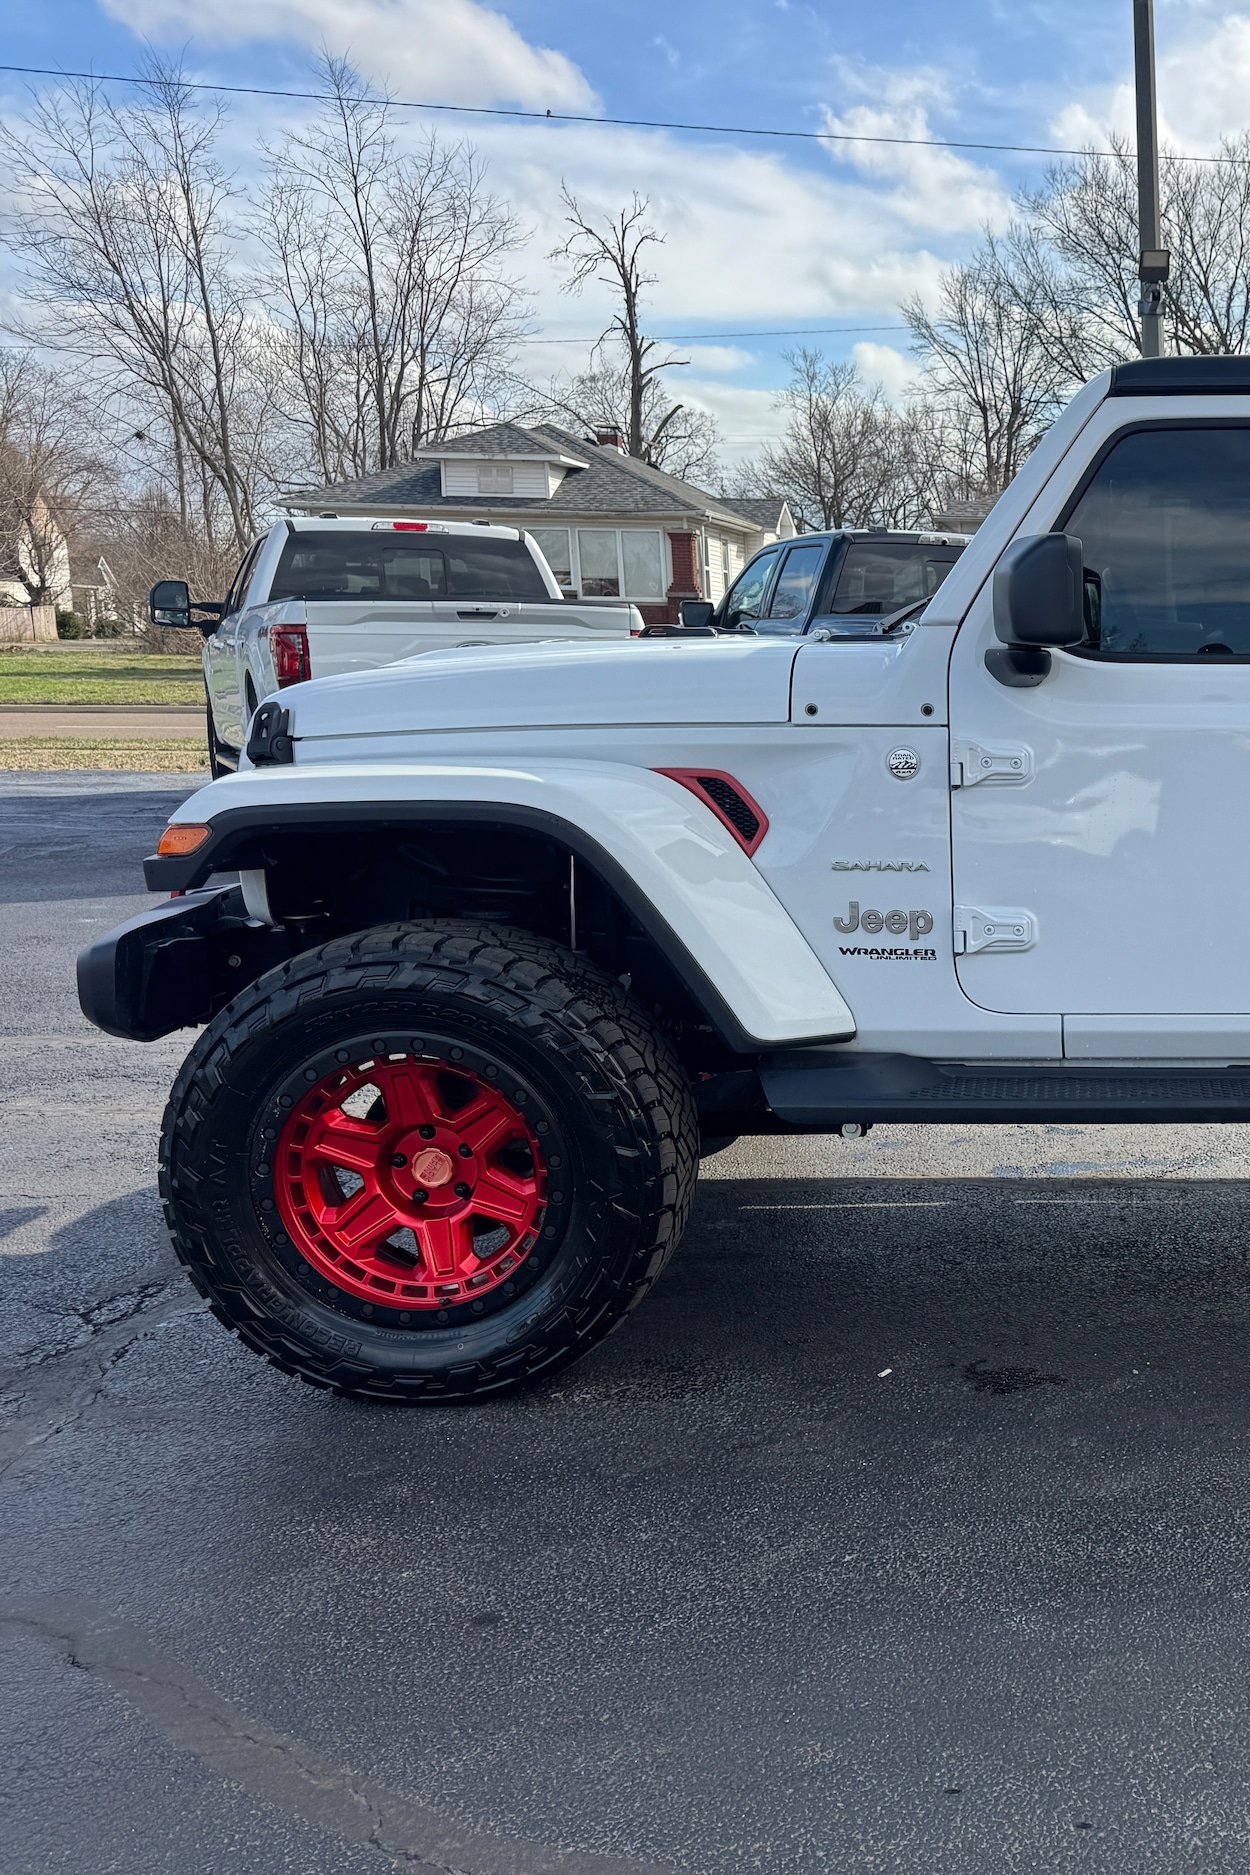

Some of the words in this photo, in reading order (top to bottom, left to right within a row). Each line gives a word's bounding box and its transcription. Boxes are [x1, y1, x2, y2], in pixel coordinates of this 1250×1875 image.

[831, 859, 931, 873] SAHARA
[832, 901, 934, 941] Jeep
[838, 946, 937, 957] WRANGLER
